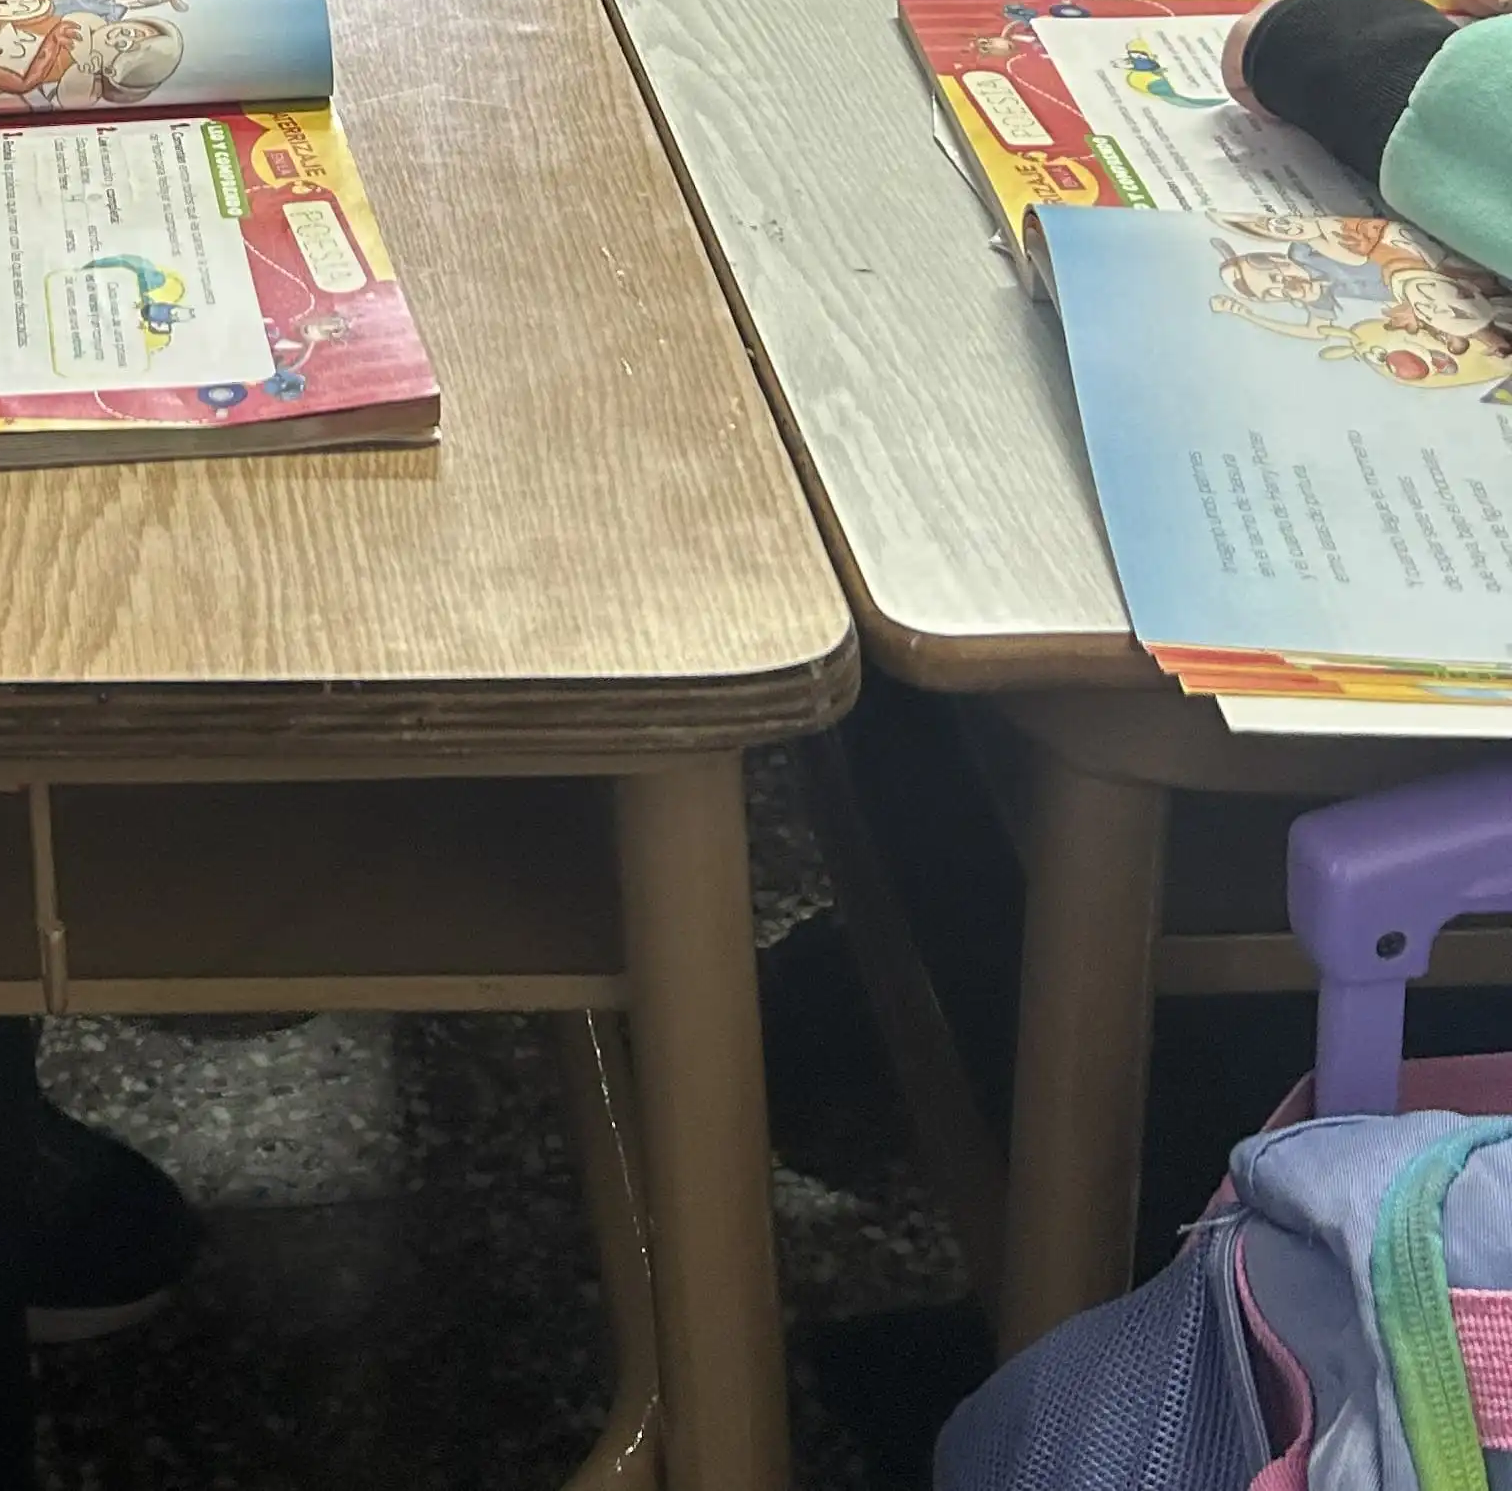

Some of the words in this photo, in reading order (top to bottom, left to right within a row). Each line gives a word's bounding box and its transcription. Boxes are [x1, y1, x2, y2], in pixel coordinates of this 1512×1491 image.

[207, 124, 225, 141] LEO
[211, 141, 227, 150] Y
[212, 150, 244, 216] COMPRENDO
